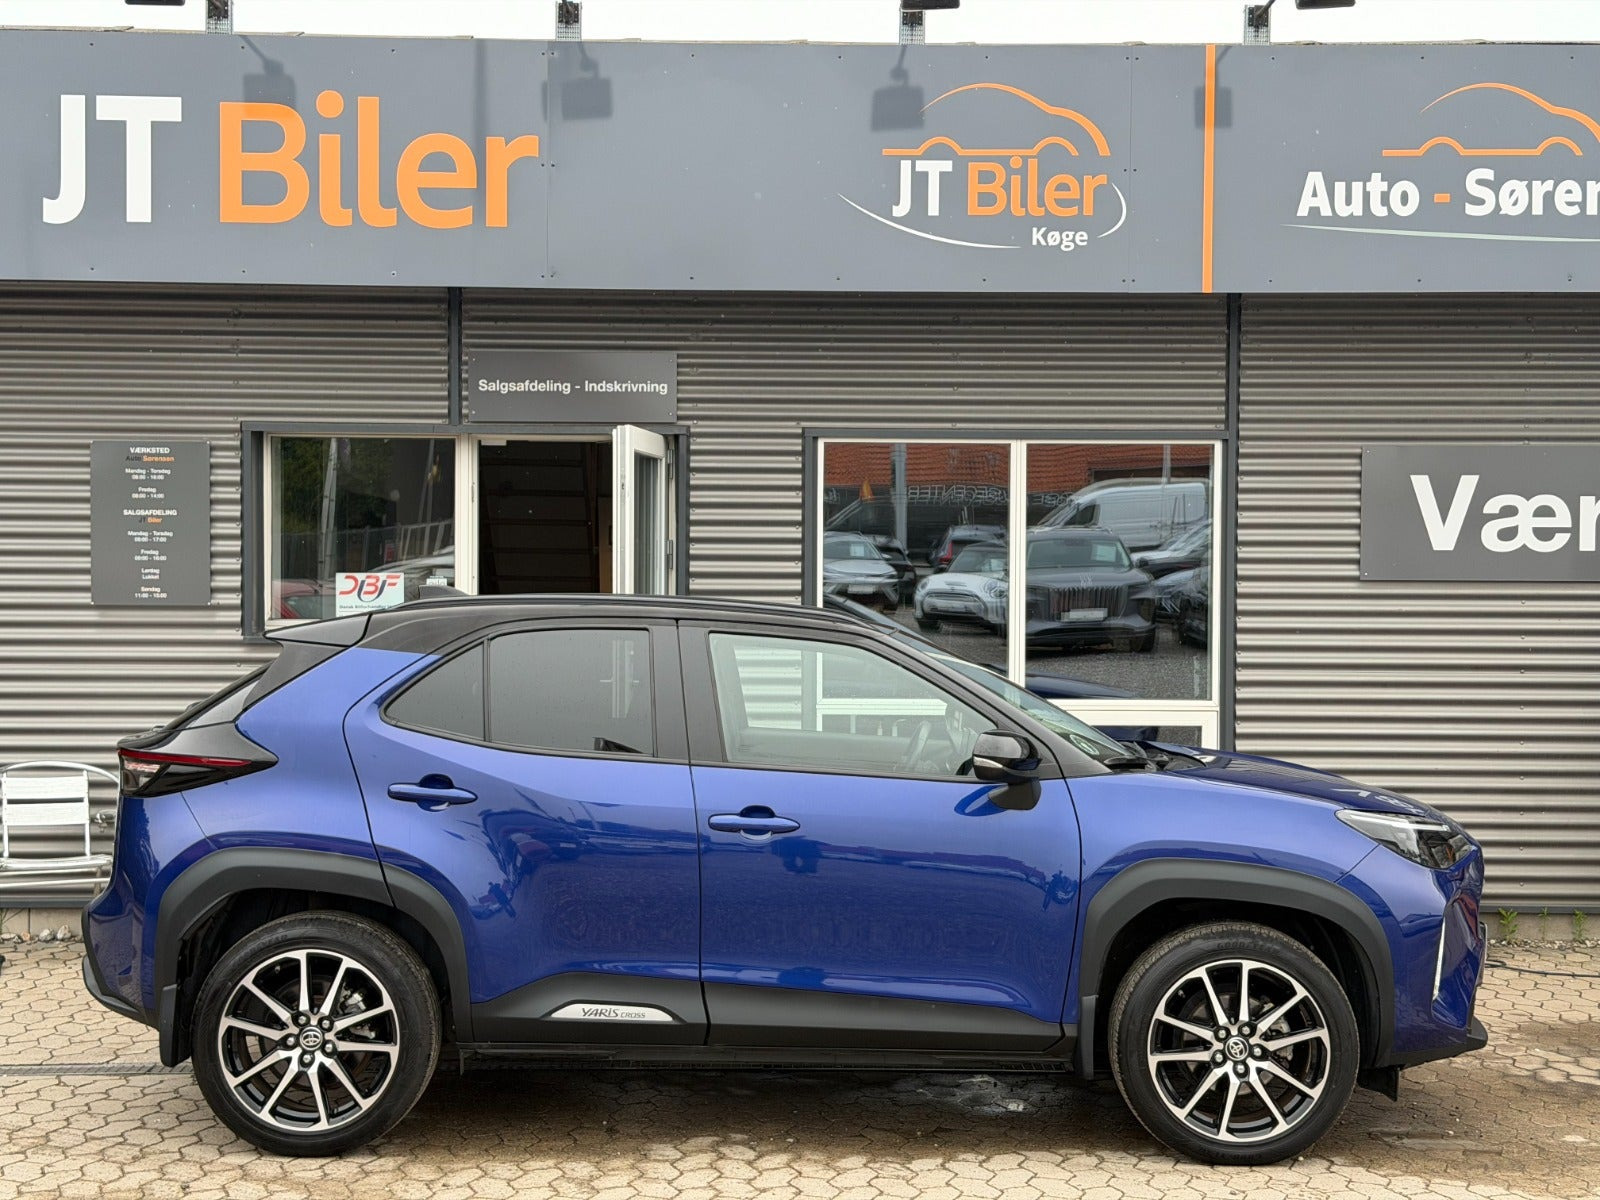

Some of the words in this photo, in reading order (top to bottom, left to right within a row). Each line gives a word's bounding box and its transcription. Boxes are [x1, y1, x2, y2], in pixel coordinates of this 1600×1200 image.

[43, 95, 182, 224] JT
[220, 90, 539, 229] Biler
[893, 159, 953, 217] JT
[966, 156, 1108, 217] Biler
[1297, 171, 1420, 217] Auto
[1434, 193, 1451, 203] -
[1032, 227, 1089, 252] Køge
[478, 379, 571, 395] Salgsafdeling
[585, 380, 668, 396] Indskrivning
[582, 1007, 620, 1018] YARIS
